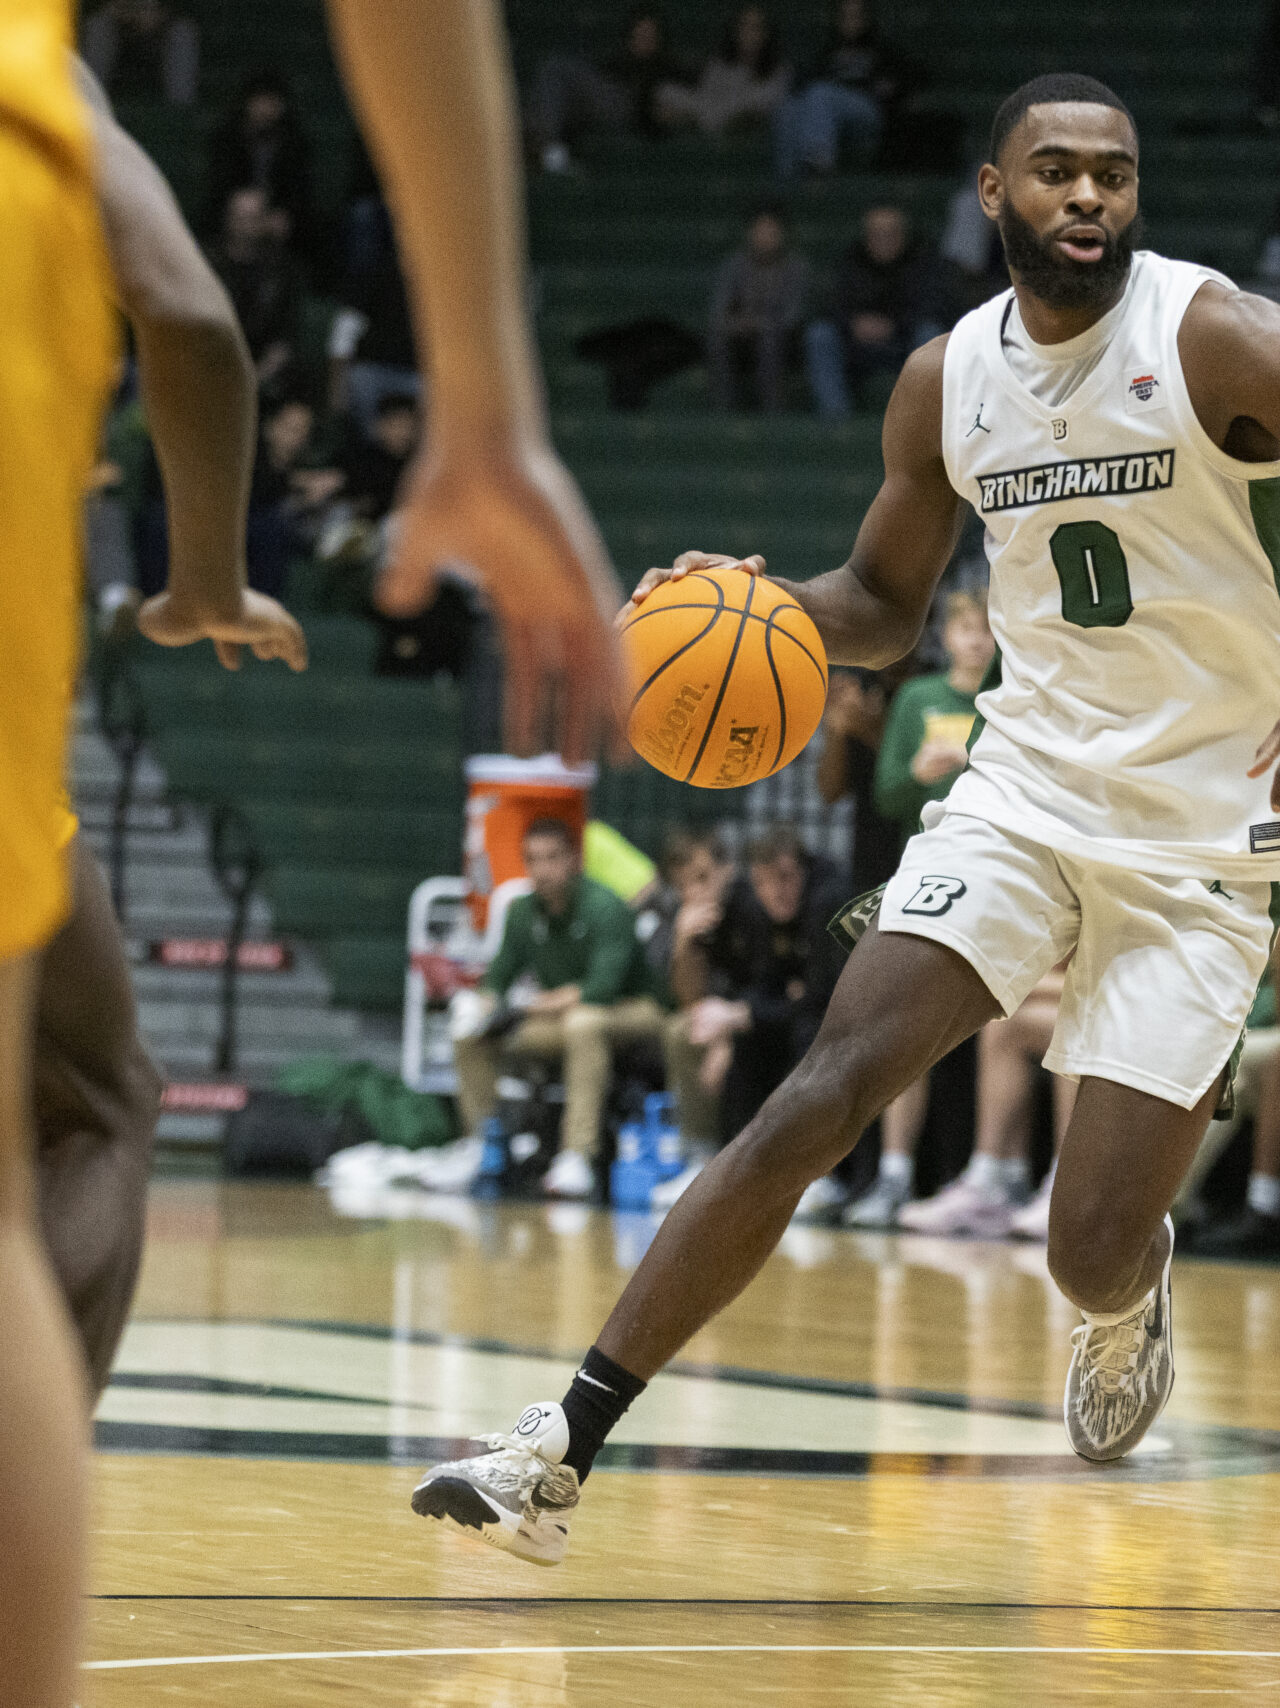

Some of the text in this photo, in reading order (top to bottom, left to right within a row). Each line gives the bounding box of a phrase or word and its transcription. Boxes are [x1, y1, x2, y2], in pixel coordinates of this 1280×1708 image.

[1129, 380, 1159, 393] AMERICA
[1135, 387, 1152, 396] EAST
[1052, 418, 1067, 439] B
[981, 453, 1171, 509] BINGHAMTON
[1049, 520, 1134, 628] 0
[902, 875, 967, 917] B
